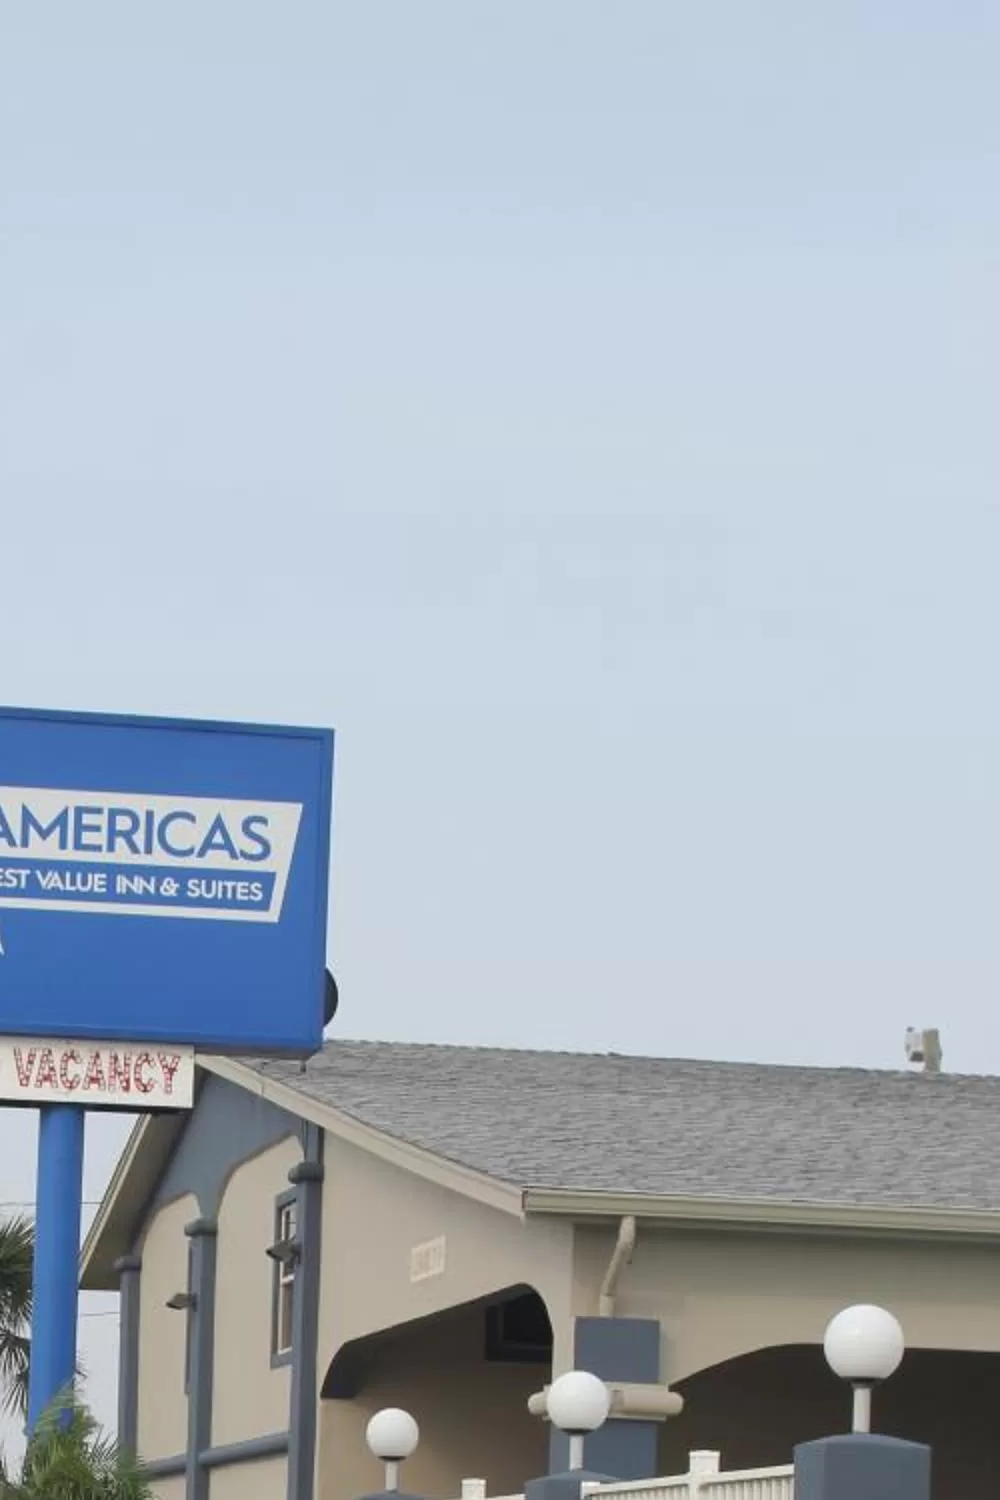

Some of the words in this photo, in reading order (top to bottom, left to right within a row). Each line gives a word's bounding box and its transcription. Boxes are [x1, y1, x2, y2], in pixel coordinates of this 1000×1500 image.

[36, 868, 107, 893] VALUE
[115, 873, 155, 895] INN
[160, 876, 180, 897] &
[187, 879, 263, 901] SUITES
[14, 1047, 181, 1094] VACANCY
